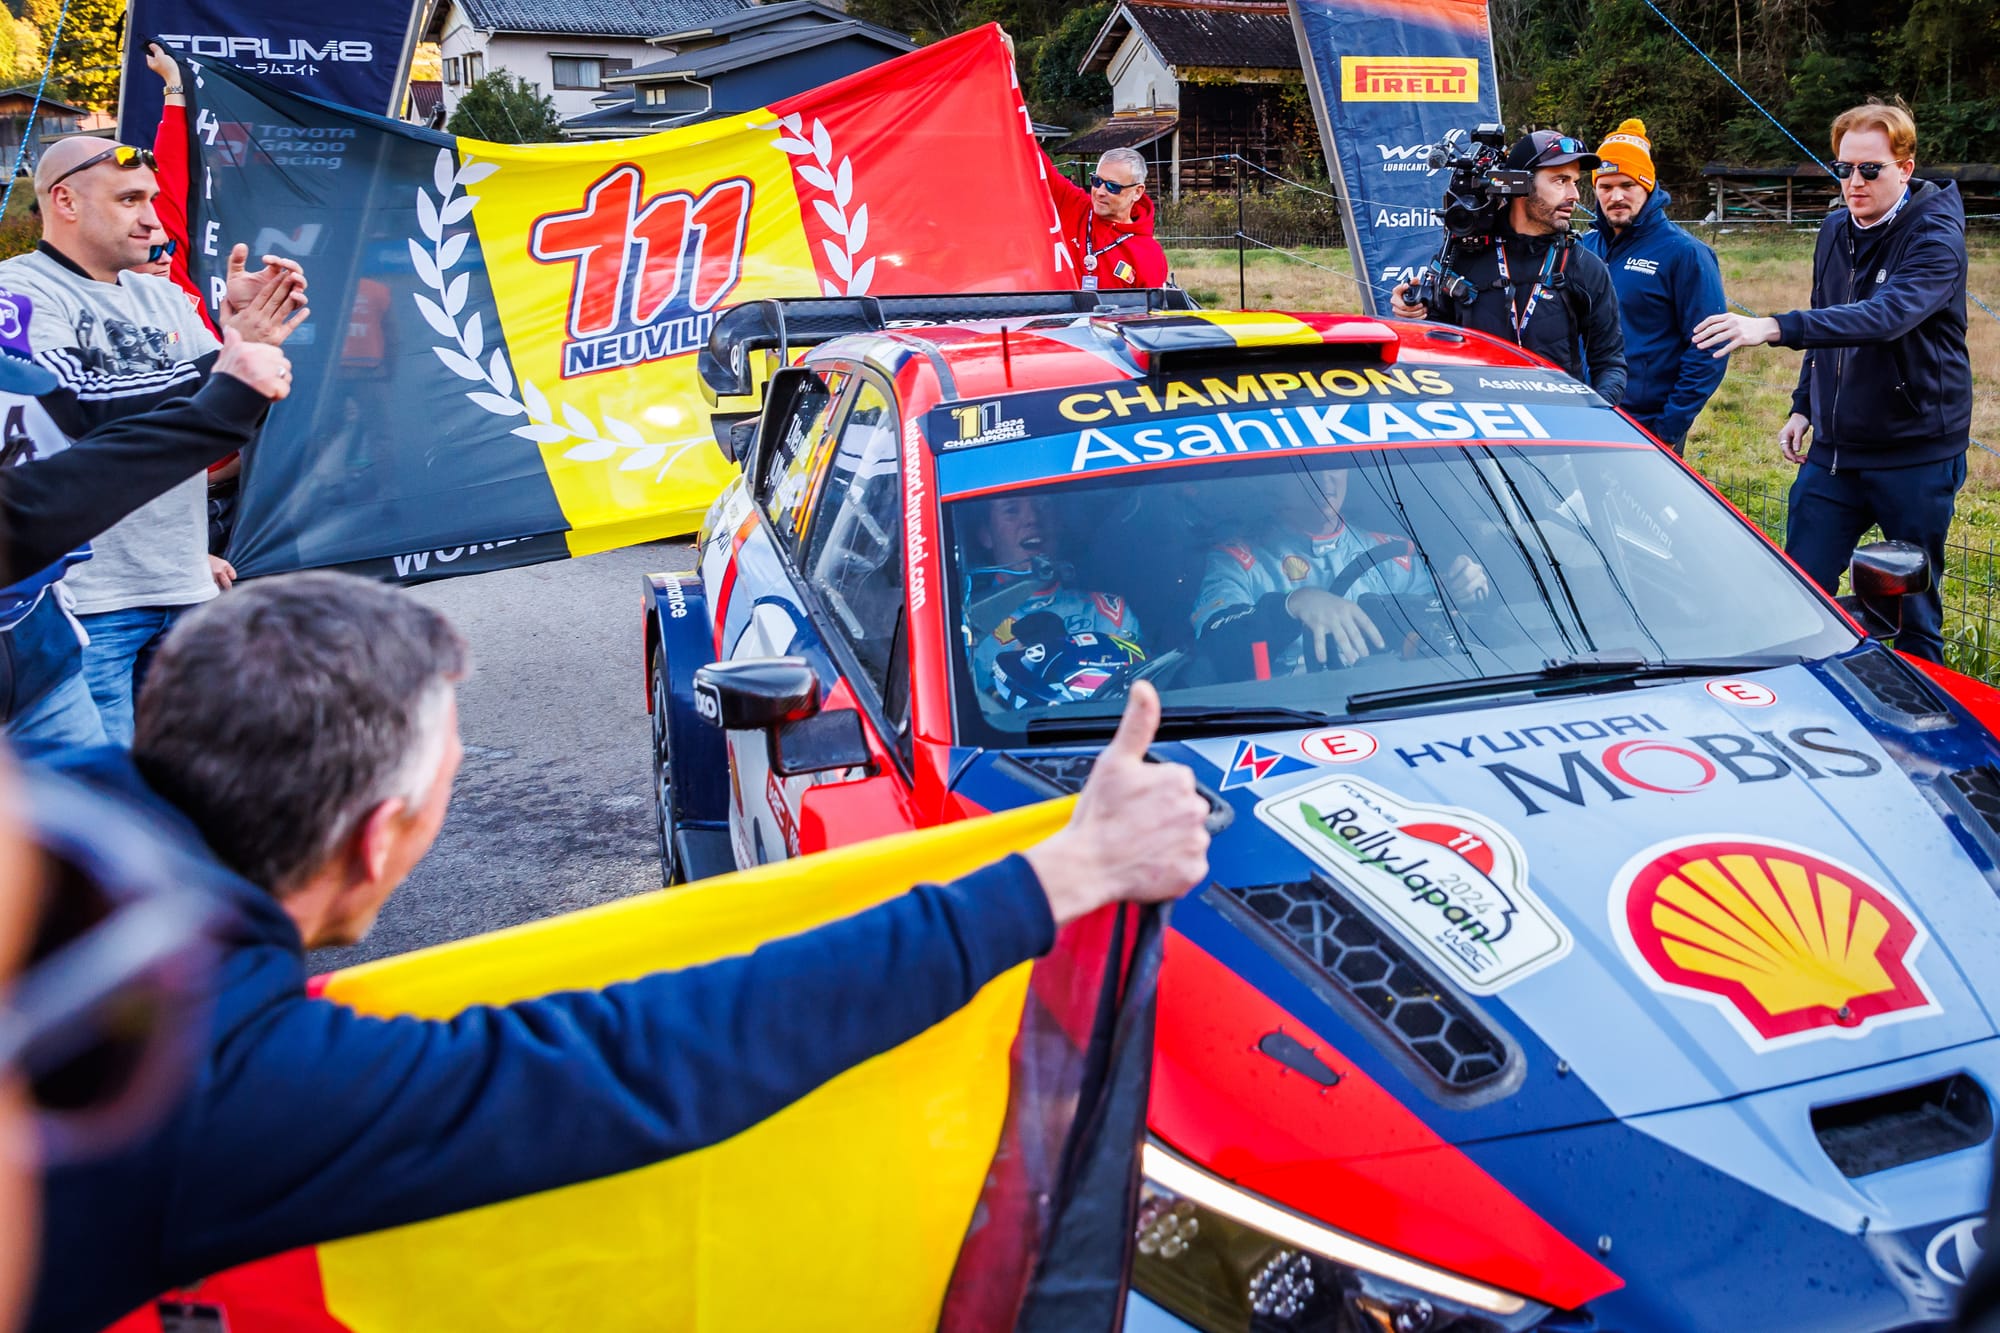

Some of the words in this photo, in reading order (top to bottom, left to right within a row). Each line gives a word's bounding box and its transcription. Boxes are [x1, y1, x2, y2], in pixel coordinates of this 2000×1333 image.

[158, 34, 373, 62] FORUM8
[1355, 65, 1468, 94] PIRELLI
[257, 125, 356, 139] TOYOTA
[1375, 208, 1445, 228] AsahiK
[567, 311, 727, 374] NEUVILL
[1058, 368, 1454, 422] CHAMPIONS
[1479, 377, 1596, 394] AsahiKASEI
[983, 425, 1025, 436] WORLD
[995, 418, 1025, 429] 2024
[943, 430, 1026, 448] CHAMPIONS
[1071, 402, 1551, 471] AsahiKASEI
[1723, 684, 1760, 701] E
[1320, 735, 1359, 756] E
[1394, 713, 1668, 768] HYUNDAI
[1480, 727, 1882, 816] MOBIS
[1447, 831, 1483, 854] 11
[1438, 873, 1495, 914] 2024
